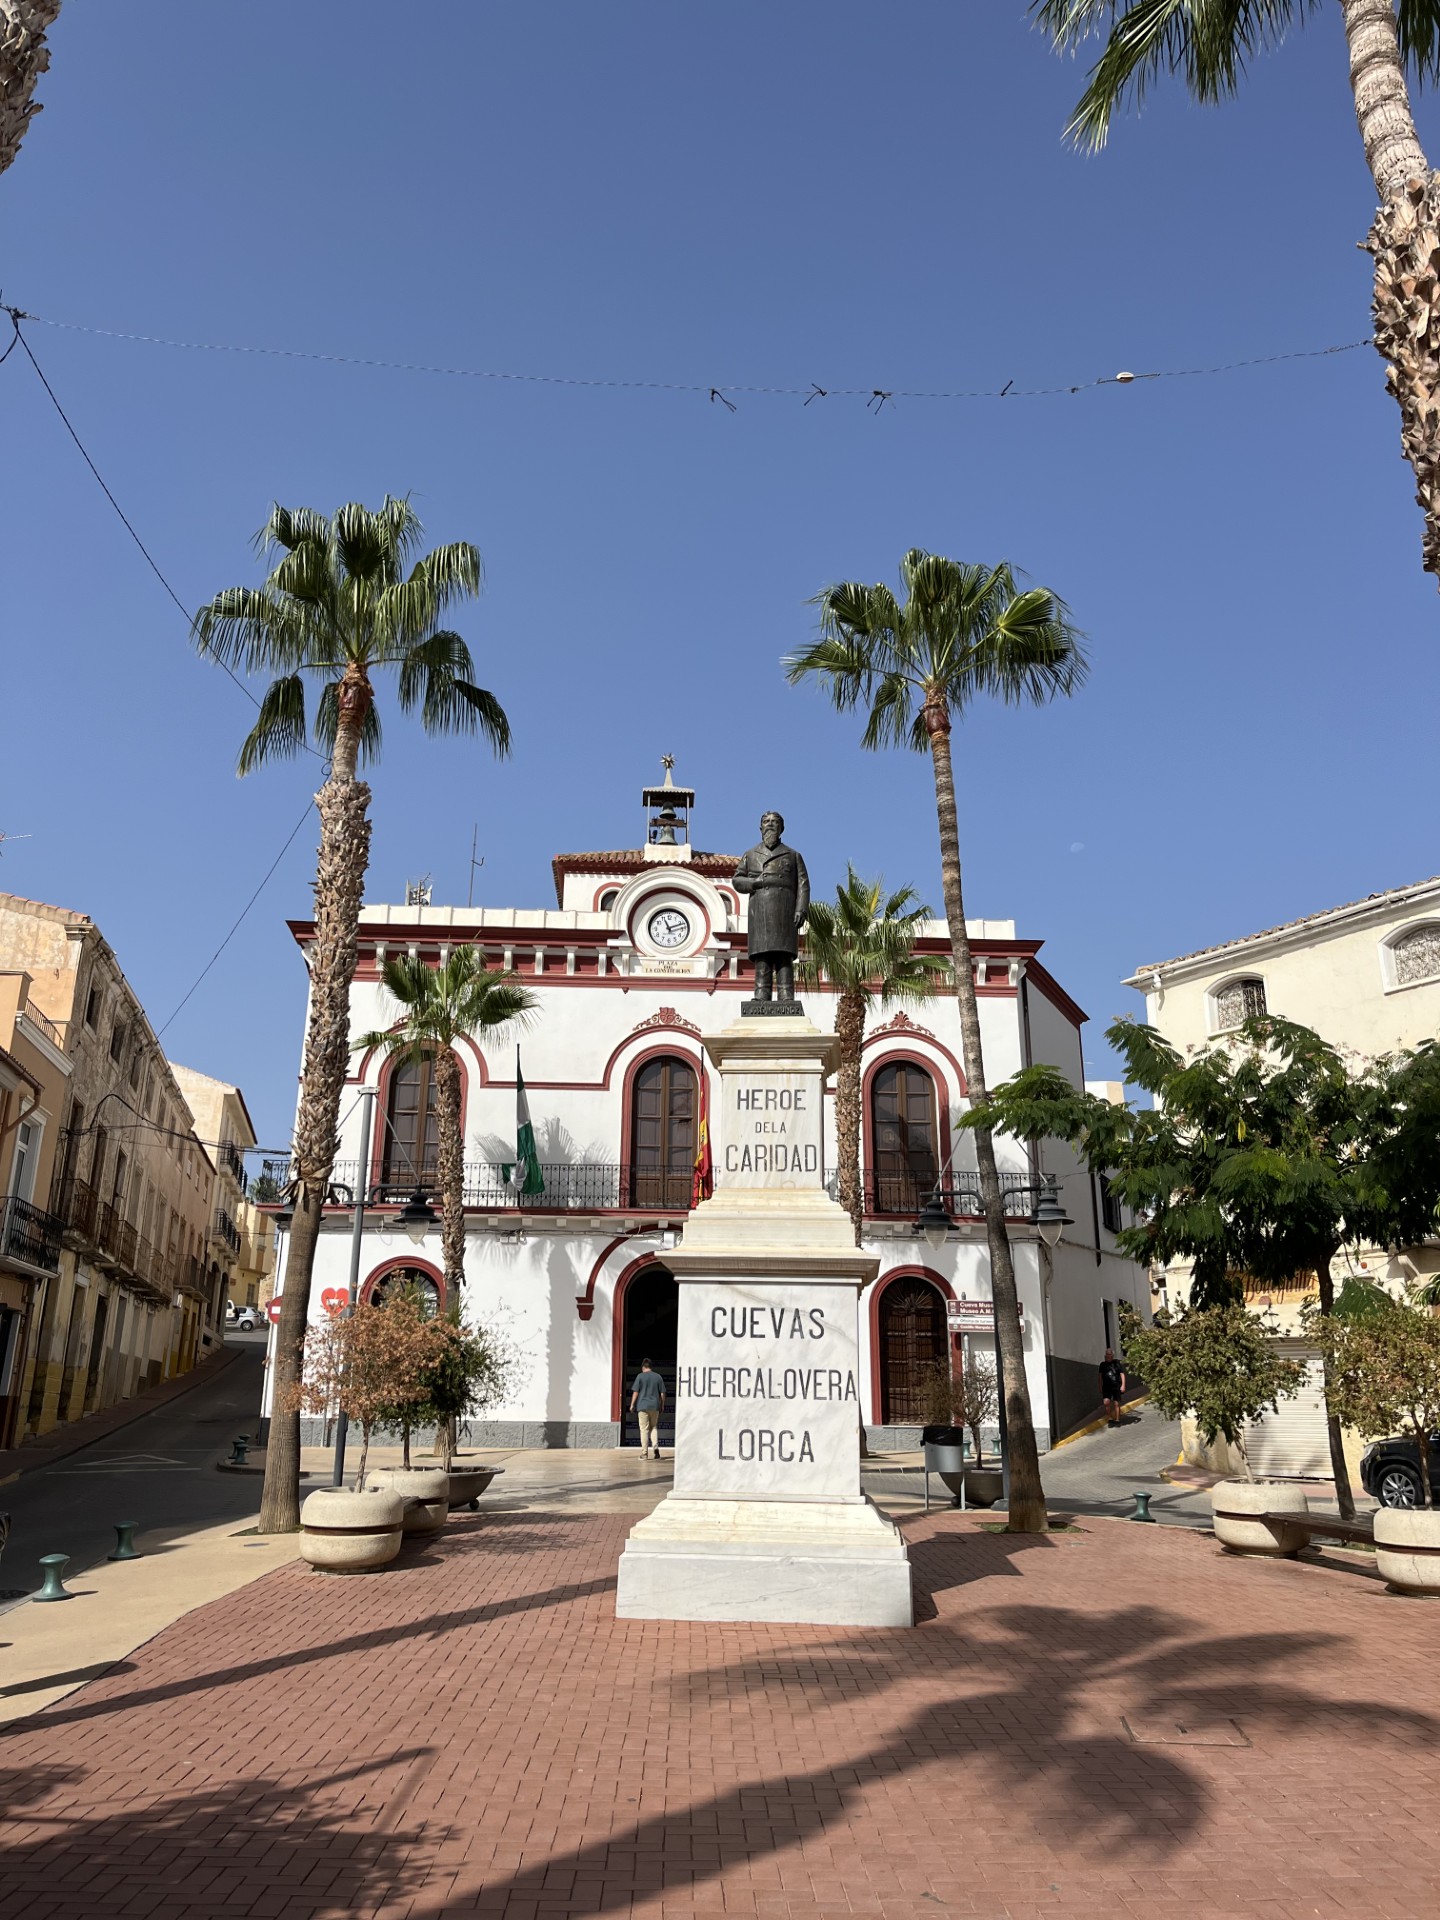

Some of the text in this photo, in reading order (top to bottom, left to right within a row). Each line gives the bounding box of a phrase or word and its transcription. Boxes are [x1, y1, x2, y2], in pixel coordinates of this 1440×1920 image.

[737, 1089, 806, 1111] HEROE
[725, 1144, 817, 1173] CARIDAD
[711, 1306, 825, 1340] CUEVAS
[678, 1366, 858, 1401] HUERCAL-OVERA
[718, 1428, 815, 1463] LORCA
